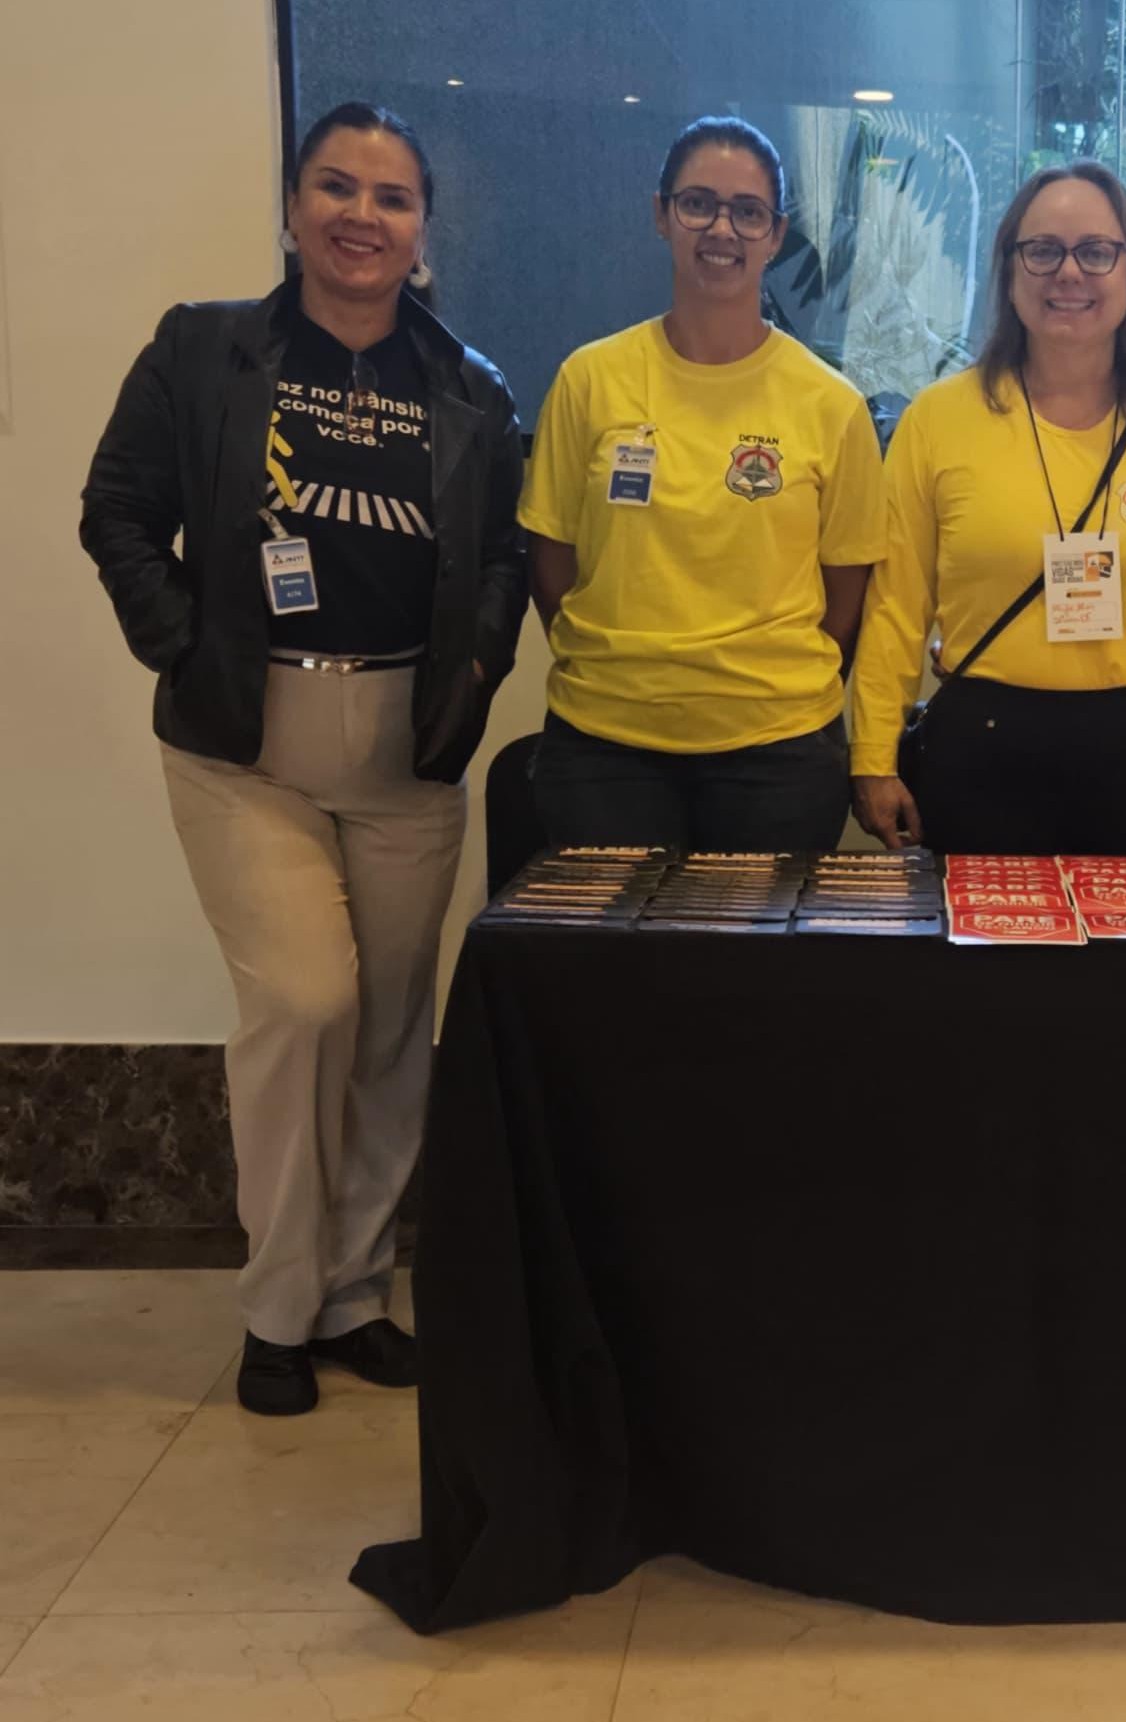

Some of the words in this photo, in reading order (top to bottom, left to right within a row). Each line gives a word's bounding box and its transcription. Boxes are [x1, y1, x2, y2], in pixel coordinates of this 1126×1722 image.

[276, 381, 304, 396] az
[311, 386, 342, 403] no
[347, 391, 429, 420] trânsit
[380, 418, 422, 437] por
[738, 433, 780, 446] DETRAN
